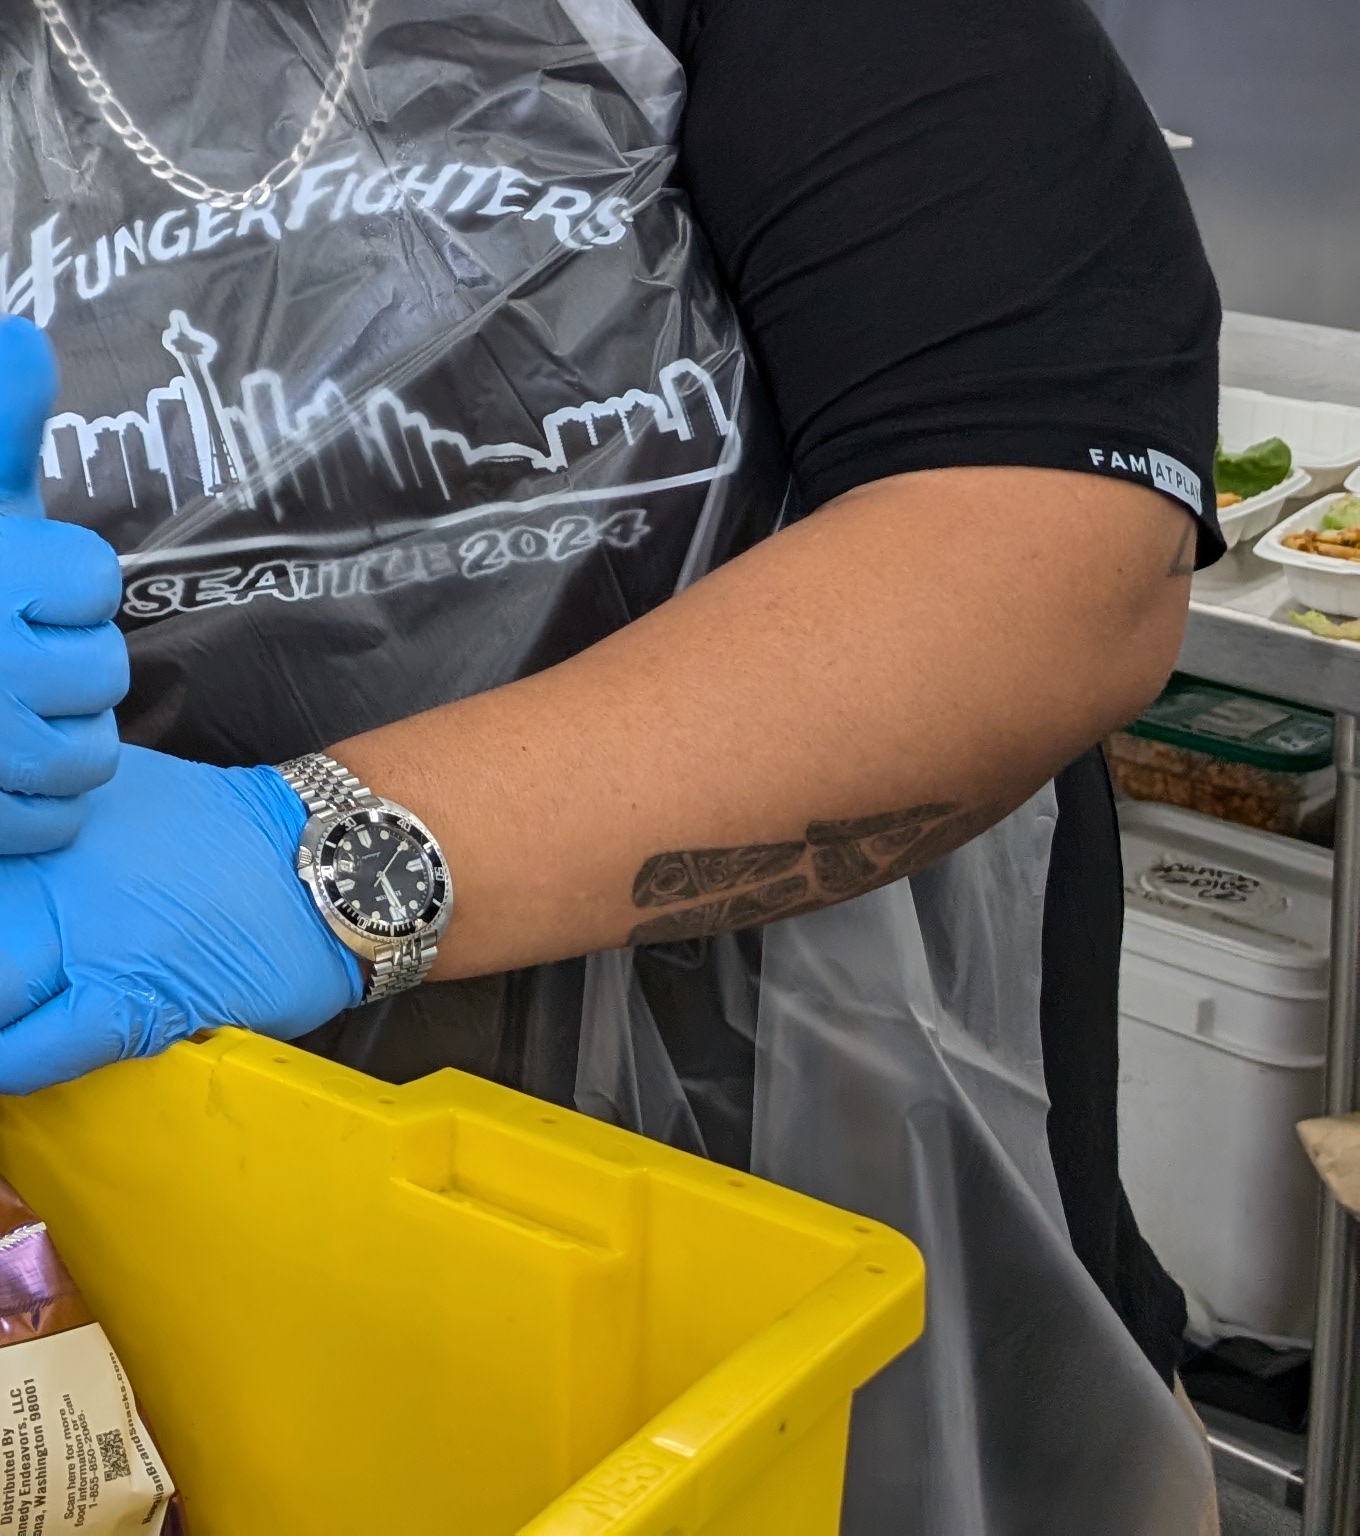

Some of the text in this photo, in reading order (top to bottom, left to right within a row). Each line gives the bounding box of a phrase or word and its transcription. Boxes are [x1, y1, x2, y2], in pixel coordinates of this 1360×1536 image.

[286, 152, 633, 250] FIGHTERS
[1088, 448, 1148, 475] FAM
[124, 507, 650, 618] SEATTLE 2024
[10, 1387, 25, 1414] LLC
[23, 1378, 41, 1421] 98001
[71, 1418, 80, 1432] or
[0, 1428, 15, 1525] Distributed By
[18, 1417, 31, 1497] Endeavors,
[33, 1425, 48, 1508] Washington
[59, 1408, 76, 1520] Scan here for more
[75, 1433, 87, 1501] information
[74, 1503, 86, 1528] food
